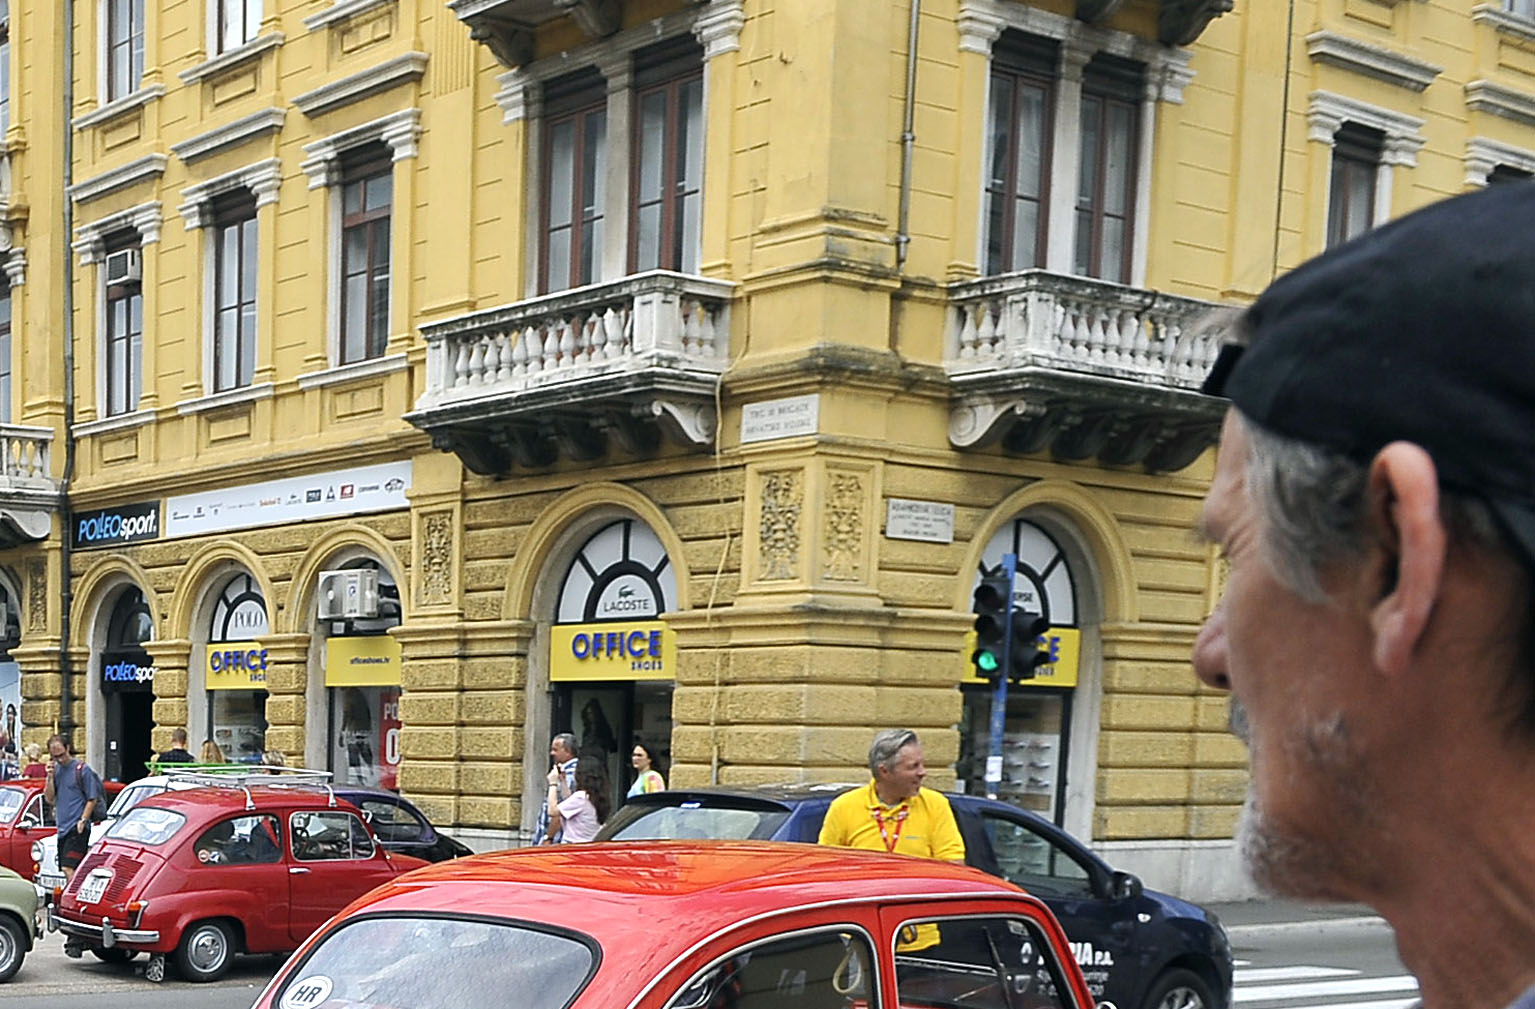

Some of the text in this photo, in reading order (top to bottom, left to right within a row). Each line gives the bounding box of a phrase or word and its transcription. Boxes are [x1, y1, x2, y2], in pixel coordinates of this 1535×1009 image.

[604, 599, 649, 612] LACOSTE
[234, 611, 263, 629] POLO
[572, 630, 662, 659] OFFICE
[211, 650, 268, 671] OFFICE
[290, 985, 322, 1003] HR
